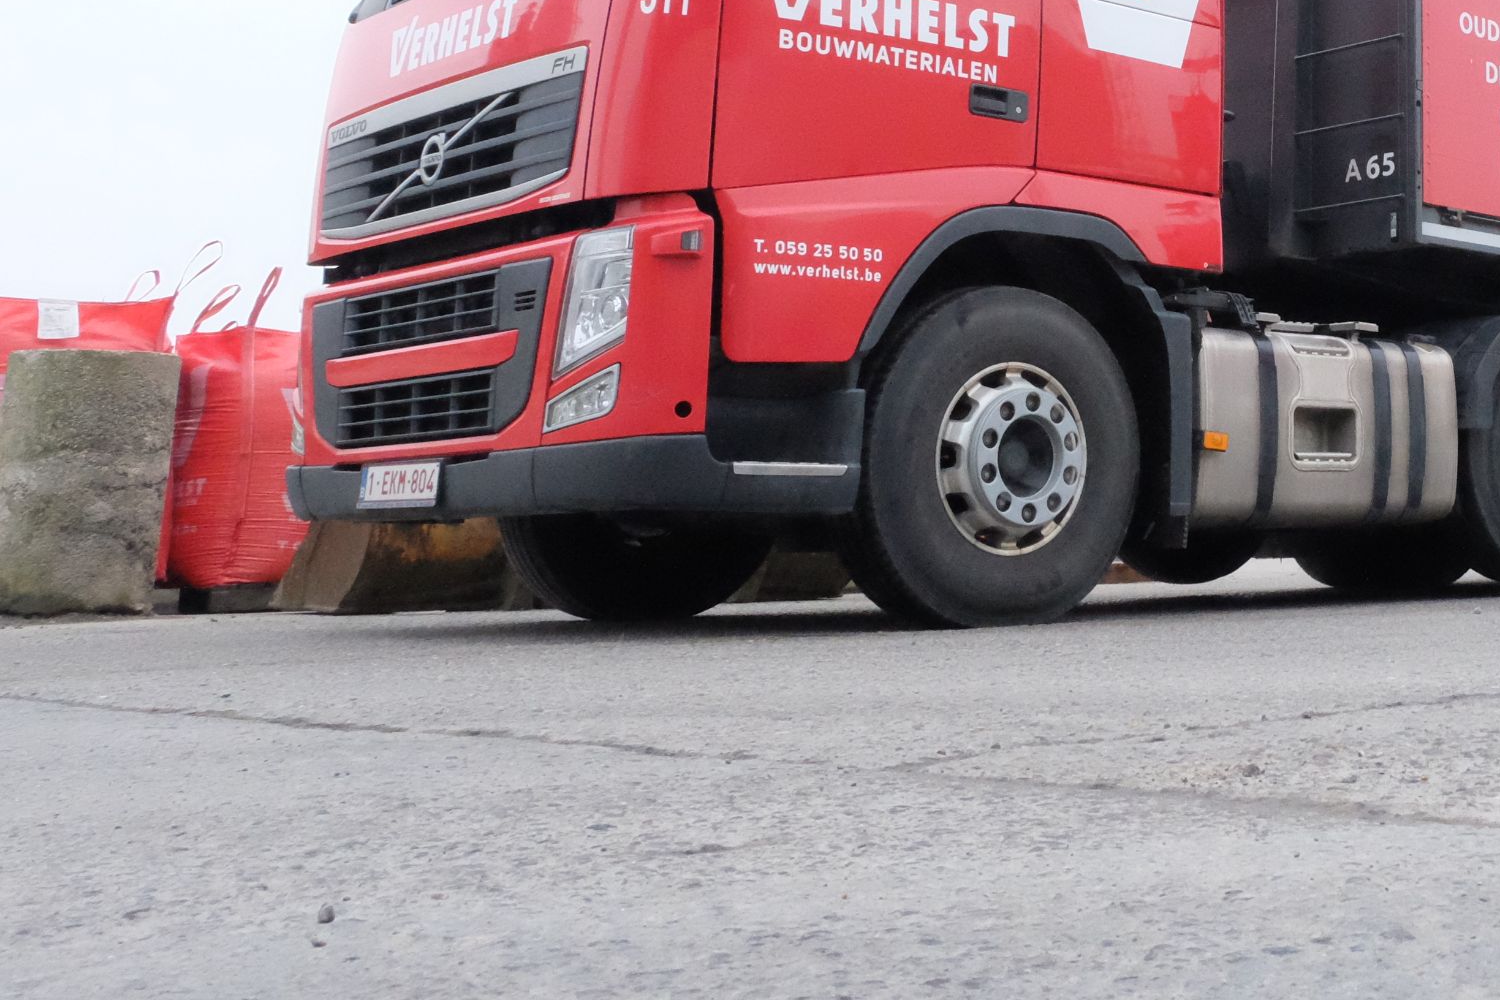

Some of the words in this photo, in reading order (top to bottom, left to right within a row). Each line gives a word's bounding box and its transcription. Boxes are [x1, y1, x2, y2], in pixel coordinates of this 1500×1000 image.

[552, 54, 576, 74] FH
[779, 29, 998, 83] BOUWMATERIALEN
[331, 120, 367, 143] VOLVO
[1345, 158, 1362, 183] A
[1366, 152, 1395, 179] 65
[753, 239, 768, 253] T.
[775, 240, 807, 256] 059
[813, 244, 833, 258] 25
[839, 246, 859, 260] 50
[863, 248, 883, 262] 50
[753, 263, 882, 282] www.verhelst.be
[368, 469, 435, 496] 1-EKM-804
